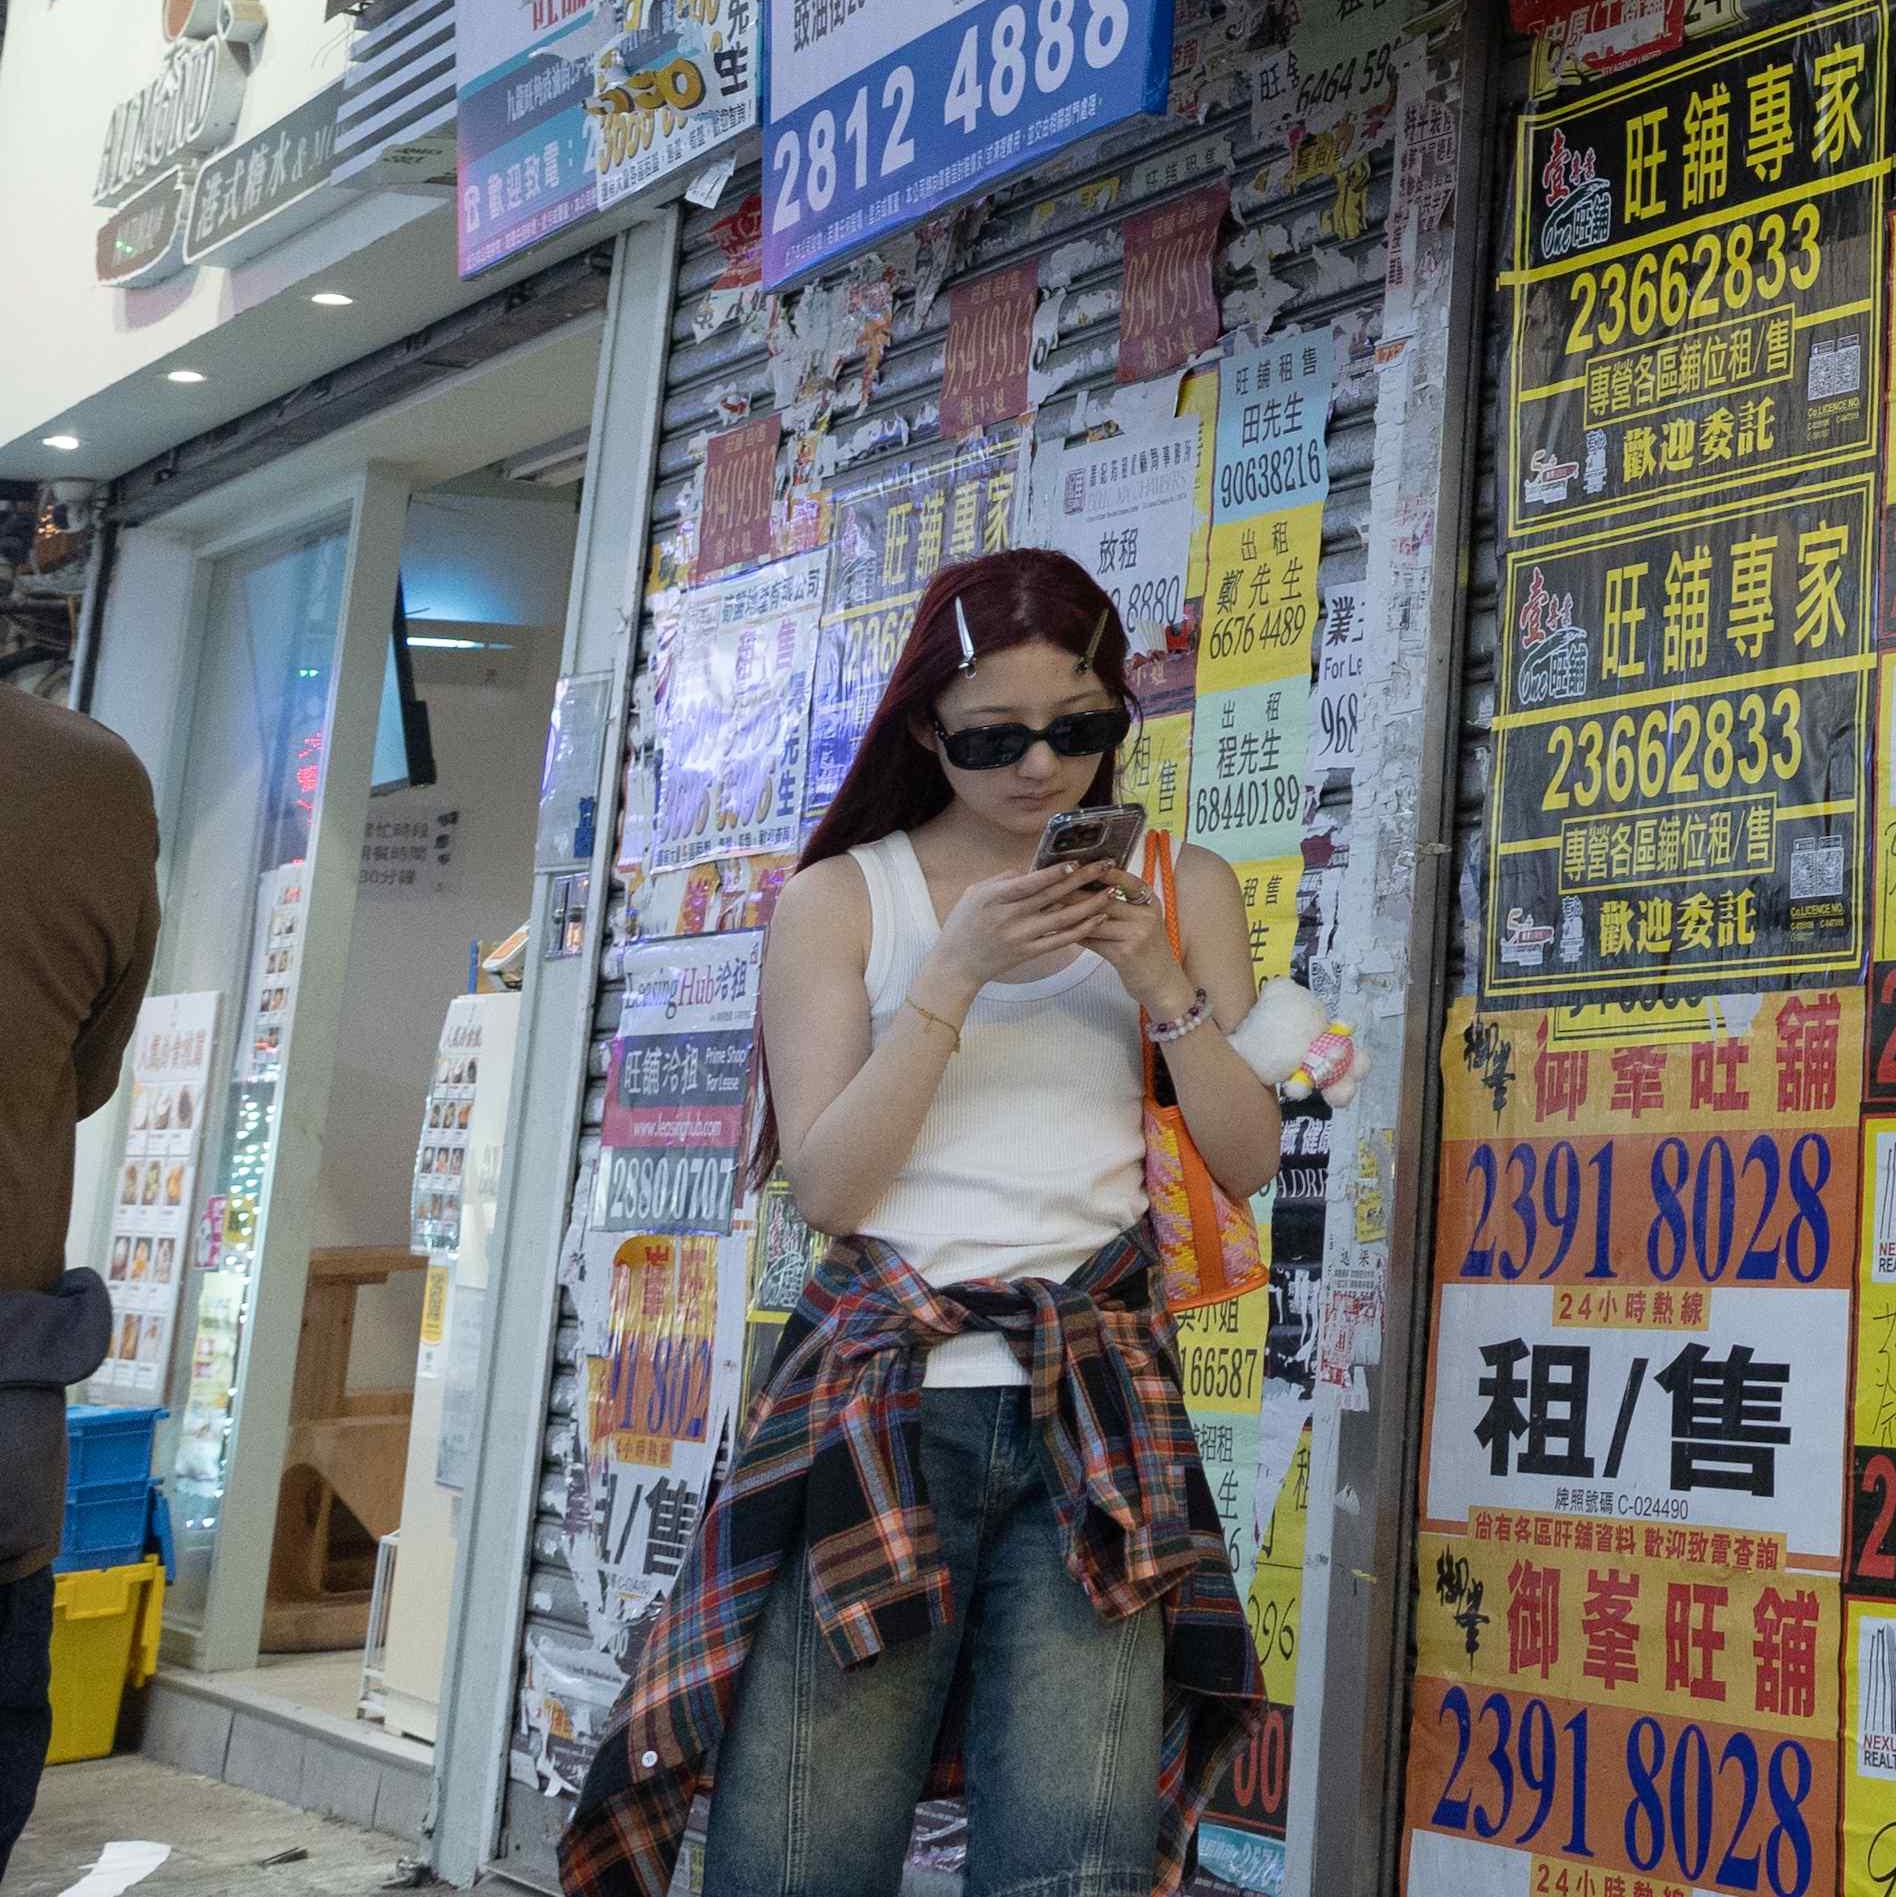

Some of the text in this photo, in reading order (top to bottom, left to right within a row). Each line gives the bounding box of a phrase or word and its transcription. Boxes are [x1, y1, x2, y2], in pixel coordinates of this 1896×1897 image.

[771, 65, 916, 235] 2812
[1625, 42, 1865, 223] 旺舖專家
[1565, 205, 1822, 355] 23662833
[1235, 344, 1318, 397] 旺舖租售
[1241, 390, 1304, 449] 田先生
[1221, 435, 1322, 507] 90638216
[1216, 558, 1304, 615] 鄭先生
[1602, 520, 1848, 682] 旺舖專家
[1211, 604, 1306, 659] 6676 4489
[1216, 727, 1283, 780] 程先生
[1543, 688, 1802, 811] 23662833
[1197, 774, 1301, 834] 68440189
[624, 1045, 699, 1096] 旺舖洽租
[611, 1158, 669, 1221] 2880
[1460, 1133, 1832, 1286] 2391 8028
[1559, 1288, 1704, 1324] 24小時熱線
[1474, 1337, 1791, 1498] 租/售
[1554, 1487, 1688, 1520] 牌照號碼 C-024490
[1644, 1528, 1779, 1572] 歡迎致電查詢
[1507, 1559, 1820, 1718] 御峯旺舖
[1432, 1685, 1595, 1858] 2391
[1624, 1715, 1813, 1897] 8028
